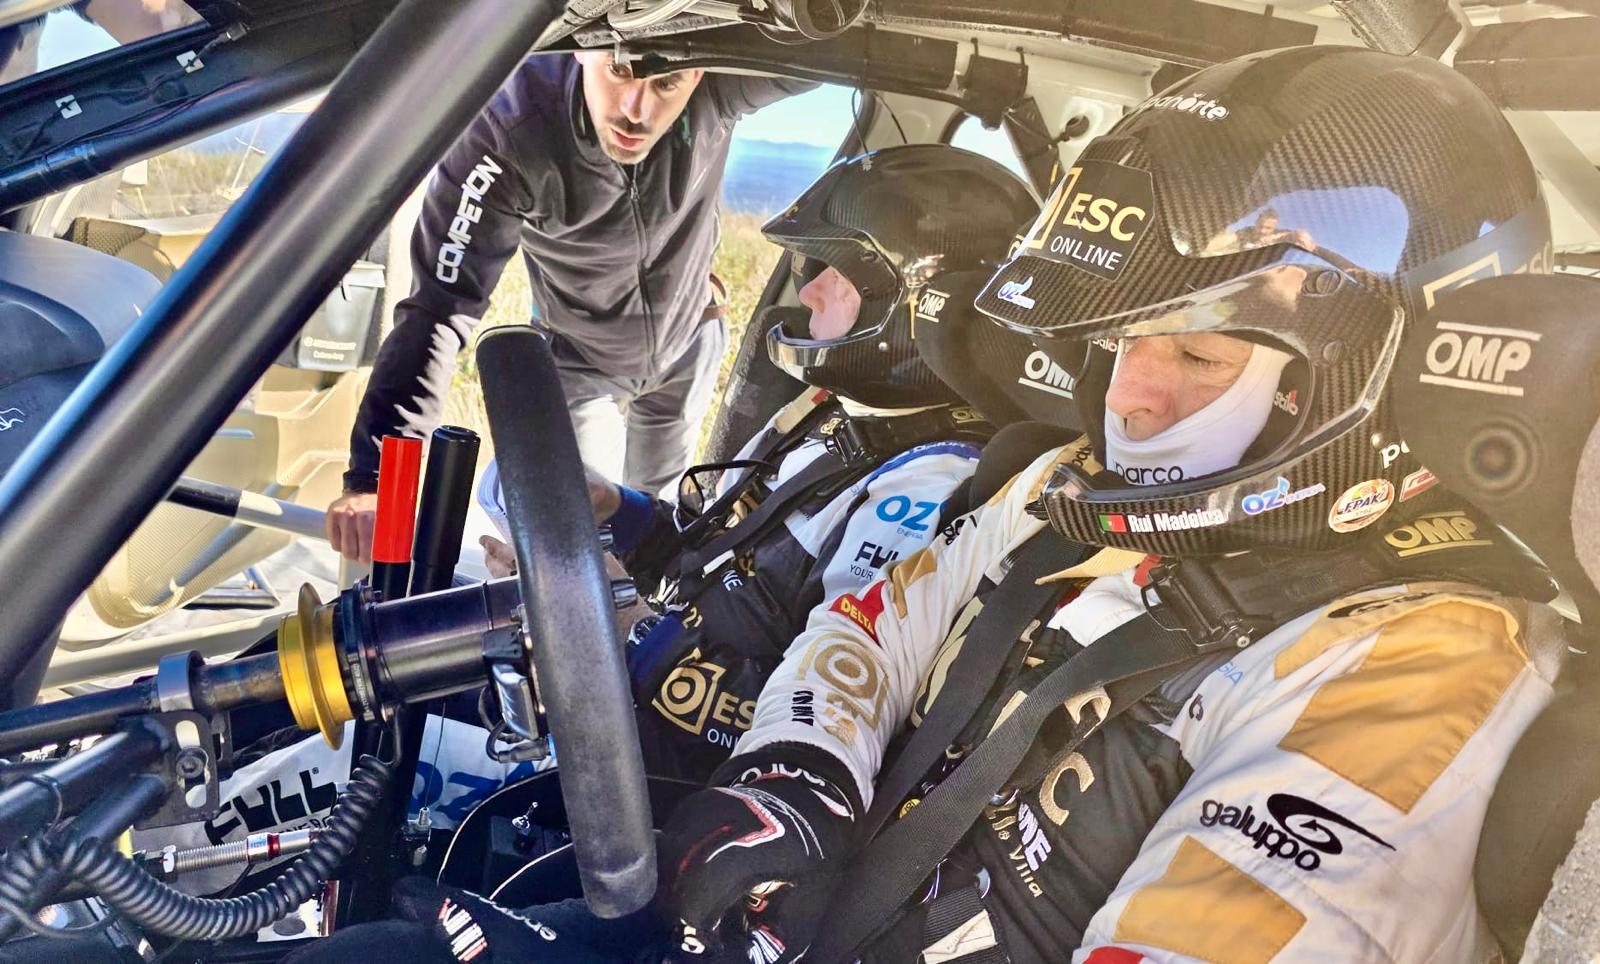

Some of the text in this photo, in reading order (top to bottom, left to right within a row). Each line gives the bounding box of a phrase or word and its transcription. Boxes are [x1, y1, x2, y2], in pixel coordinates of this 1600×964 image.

[1062, 192, 1146, 242] ESC
[1050, 235, 1123, 271] ONLINE
[918, 292, 946, 317] OMP
[1024, 350, 1076, 391] OM
[1425, 331, 1533, 383] OMP
[1113, 460, 1184, 485] parco
[1127, 513, 1155, 533] Rui
[1384, 516, 1478, 550] OMP
[849, 564, 875, 581] YOUR
[840, 596, 876, 636] DELTA
[711, 691, 757, 731] ES
[203, 768, 338, 848] FULL
[1199, 799, 1322, 872] galuppo
